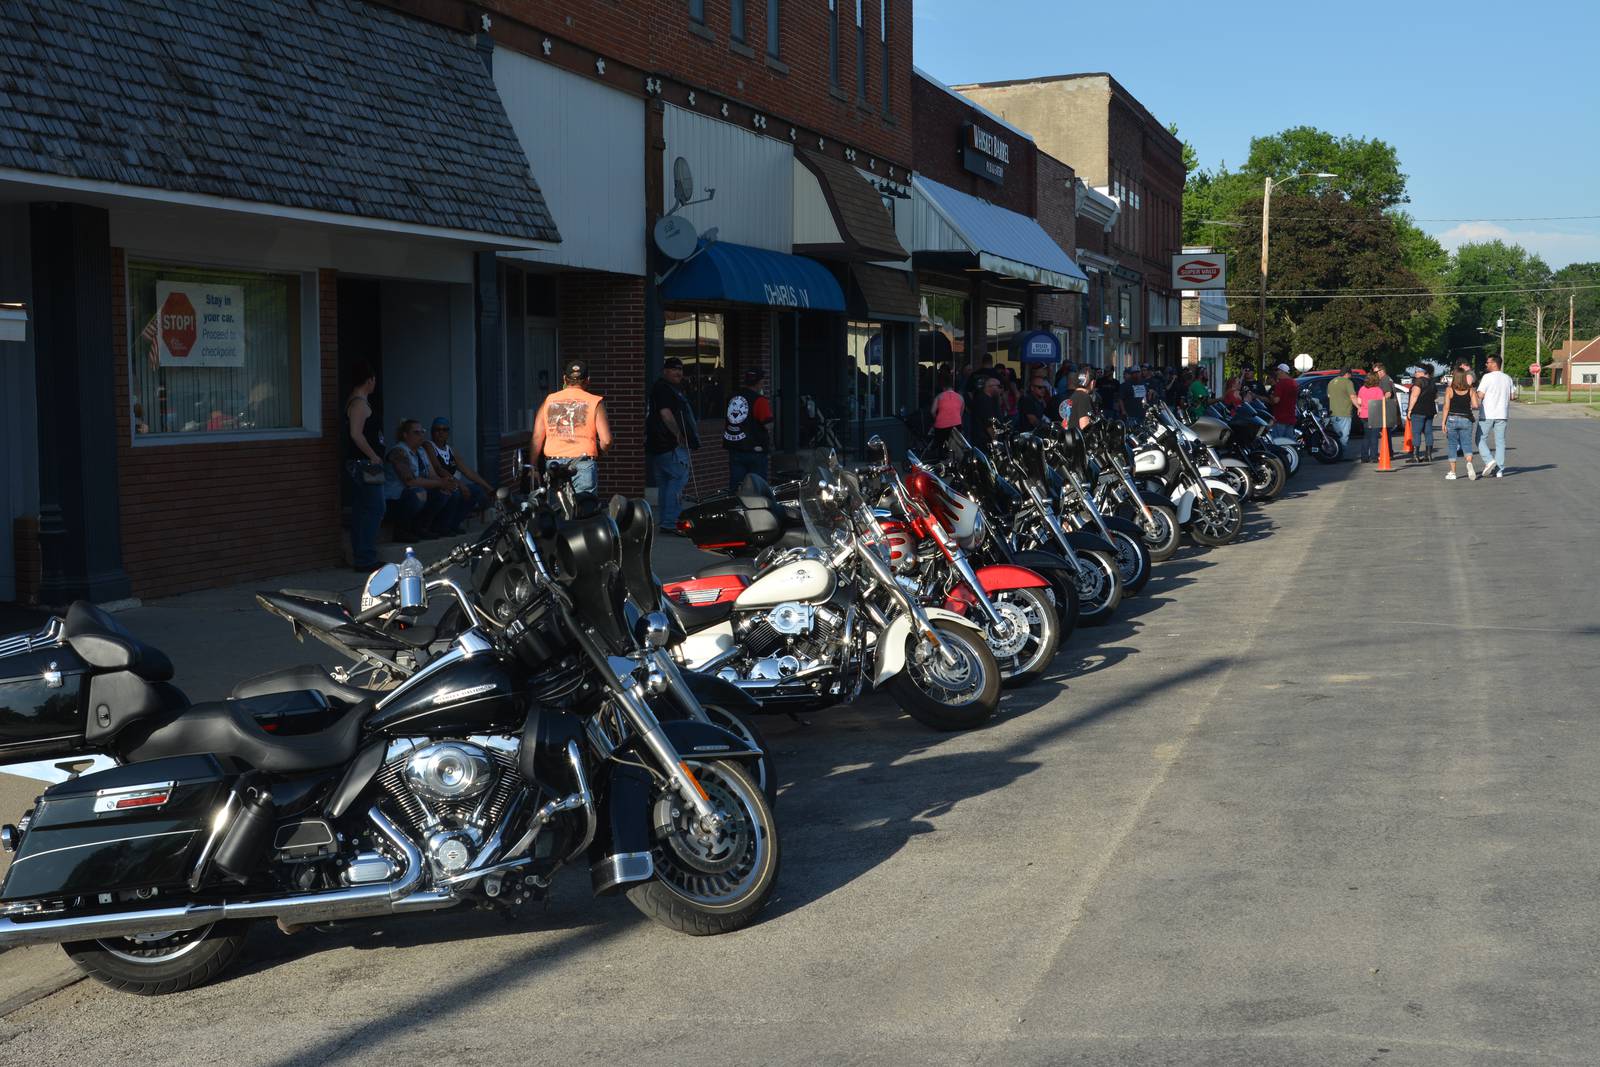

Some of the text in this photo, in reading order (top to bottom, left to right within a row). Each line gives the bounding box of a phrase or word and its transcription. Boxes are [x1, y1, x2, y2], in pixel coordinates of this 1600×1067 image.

[206, 294, 231, 308] Stay in
[163, 314, 194, 331] STOP!
[203, 314, 234, 324] your car.
